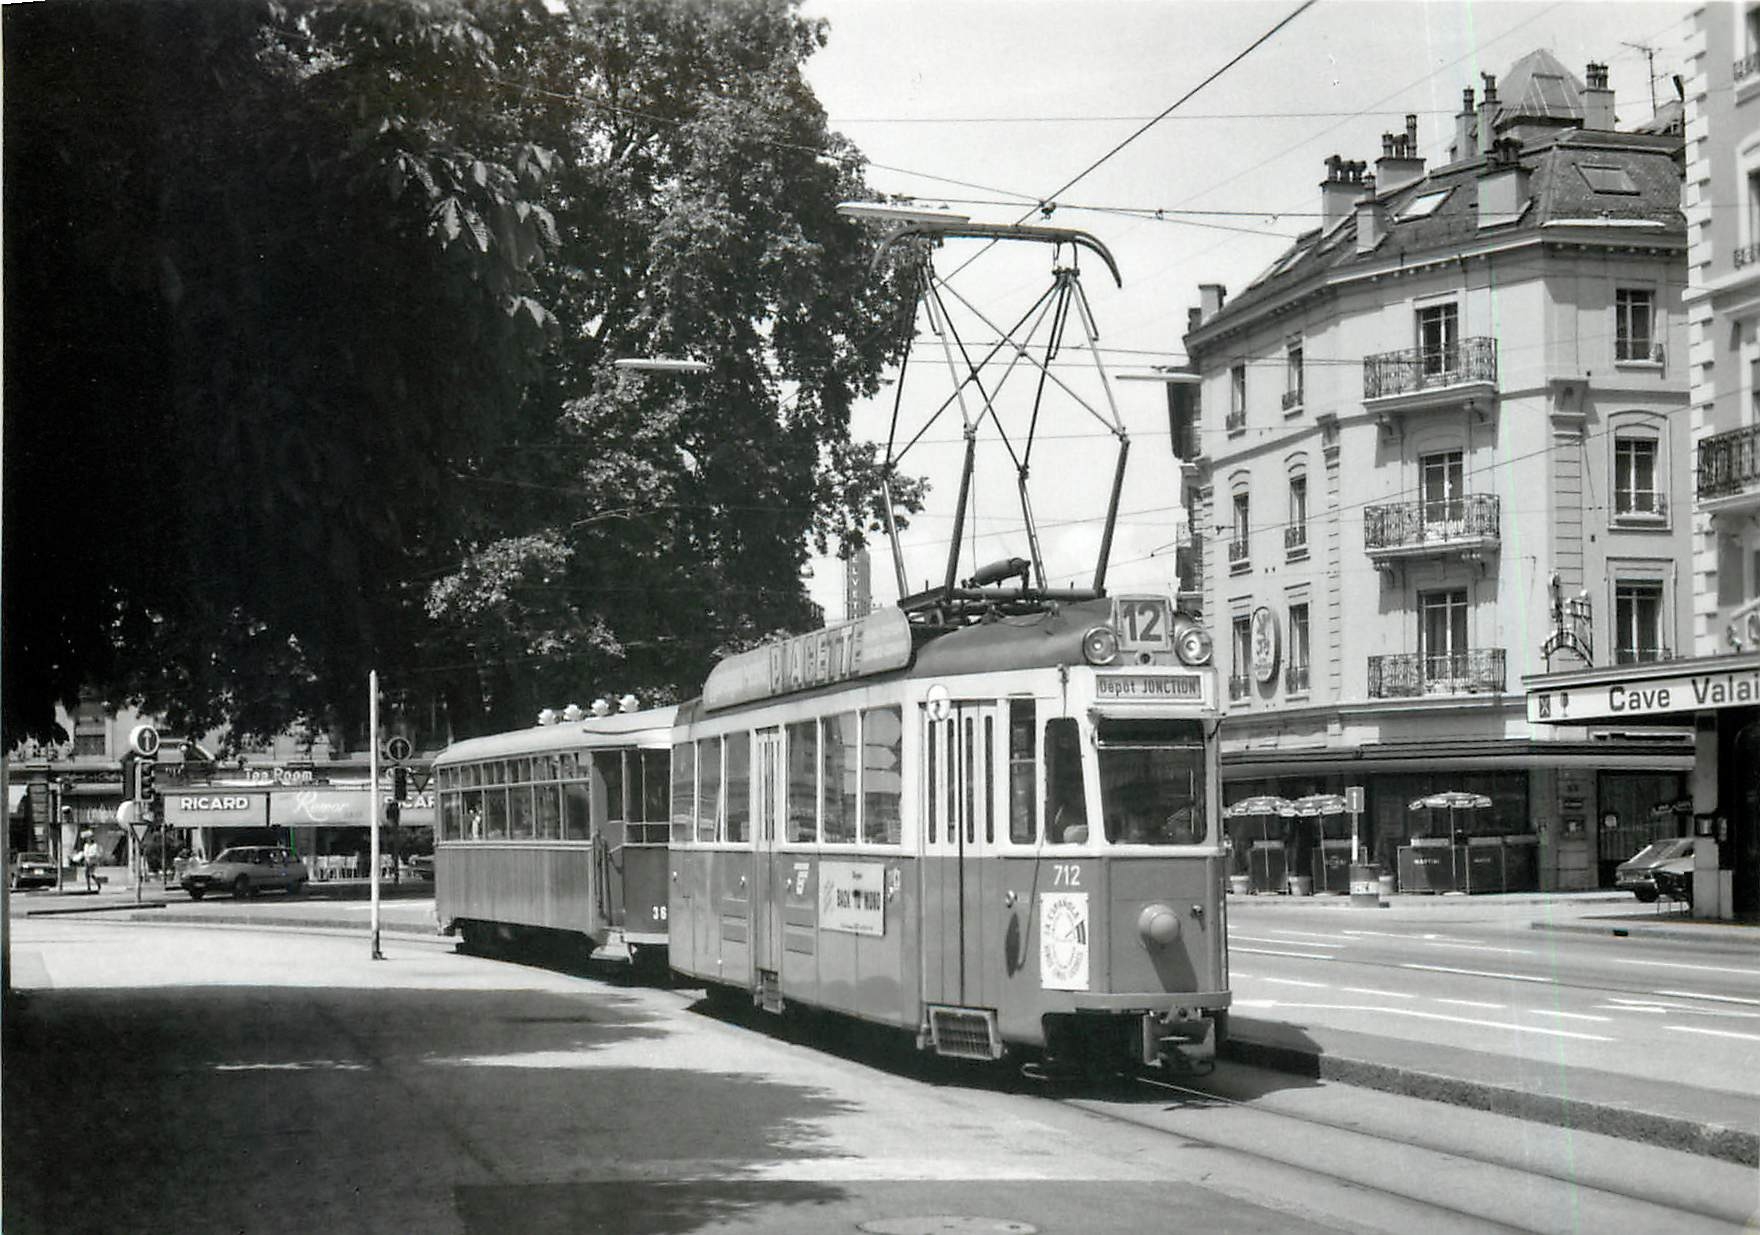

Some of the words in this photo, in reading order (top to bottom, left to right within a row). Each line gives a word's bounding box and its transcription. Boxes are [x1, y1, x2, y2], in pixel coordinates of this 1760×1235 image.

[1123, 603, 1163, 642] 12
[1142, 679, 1197, 695] JONCTION
[1609, 685, 1671, 712] Cave
[273, 767, 313, 783] Room
[180, 796, 249, 810] RICARD
[1053, 864, 1081, 886] 712
